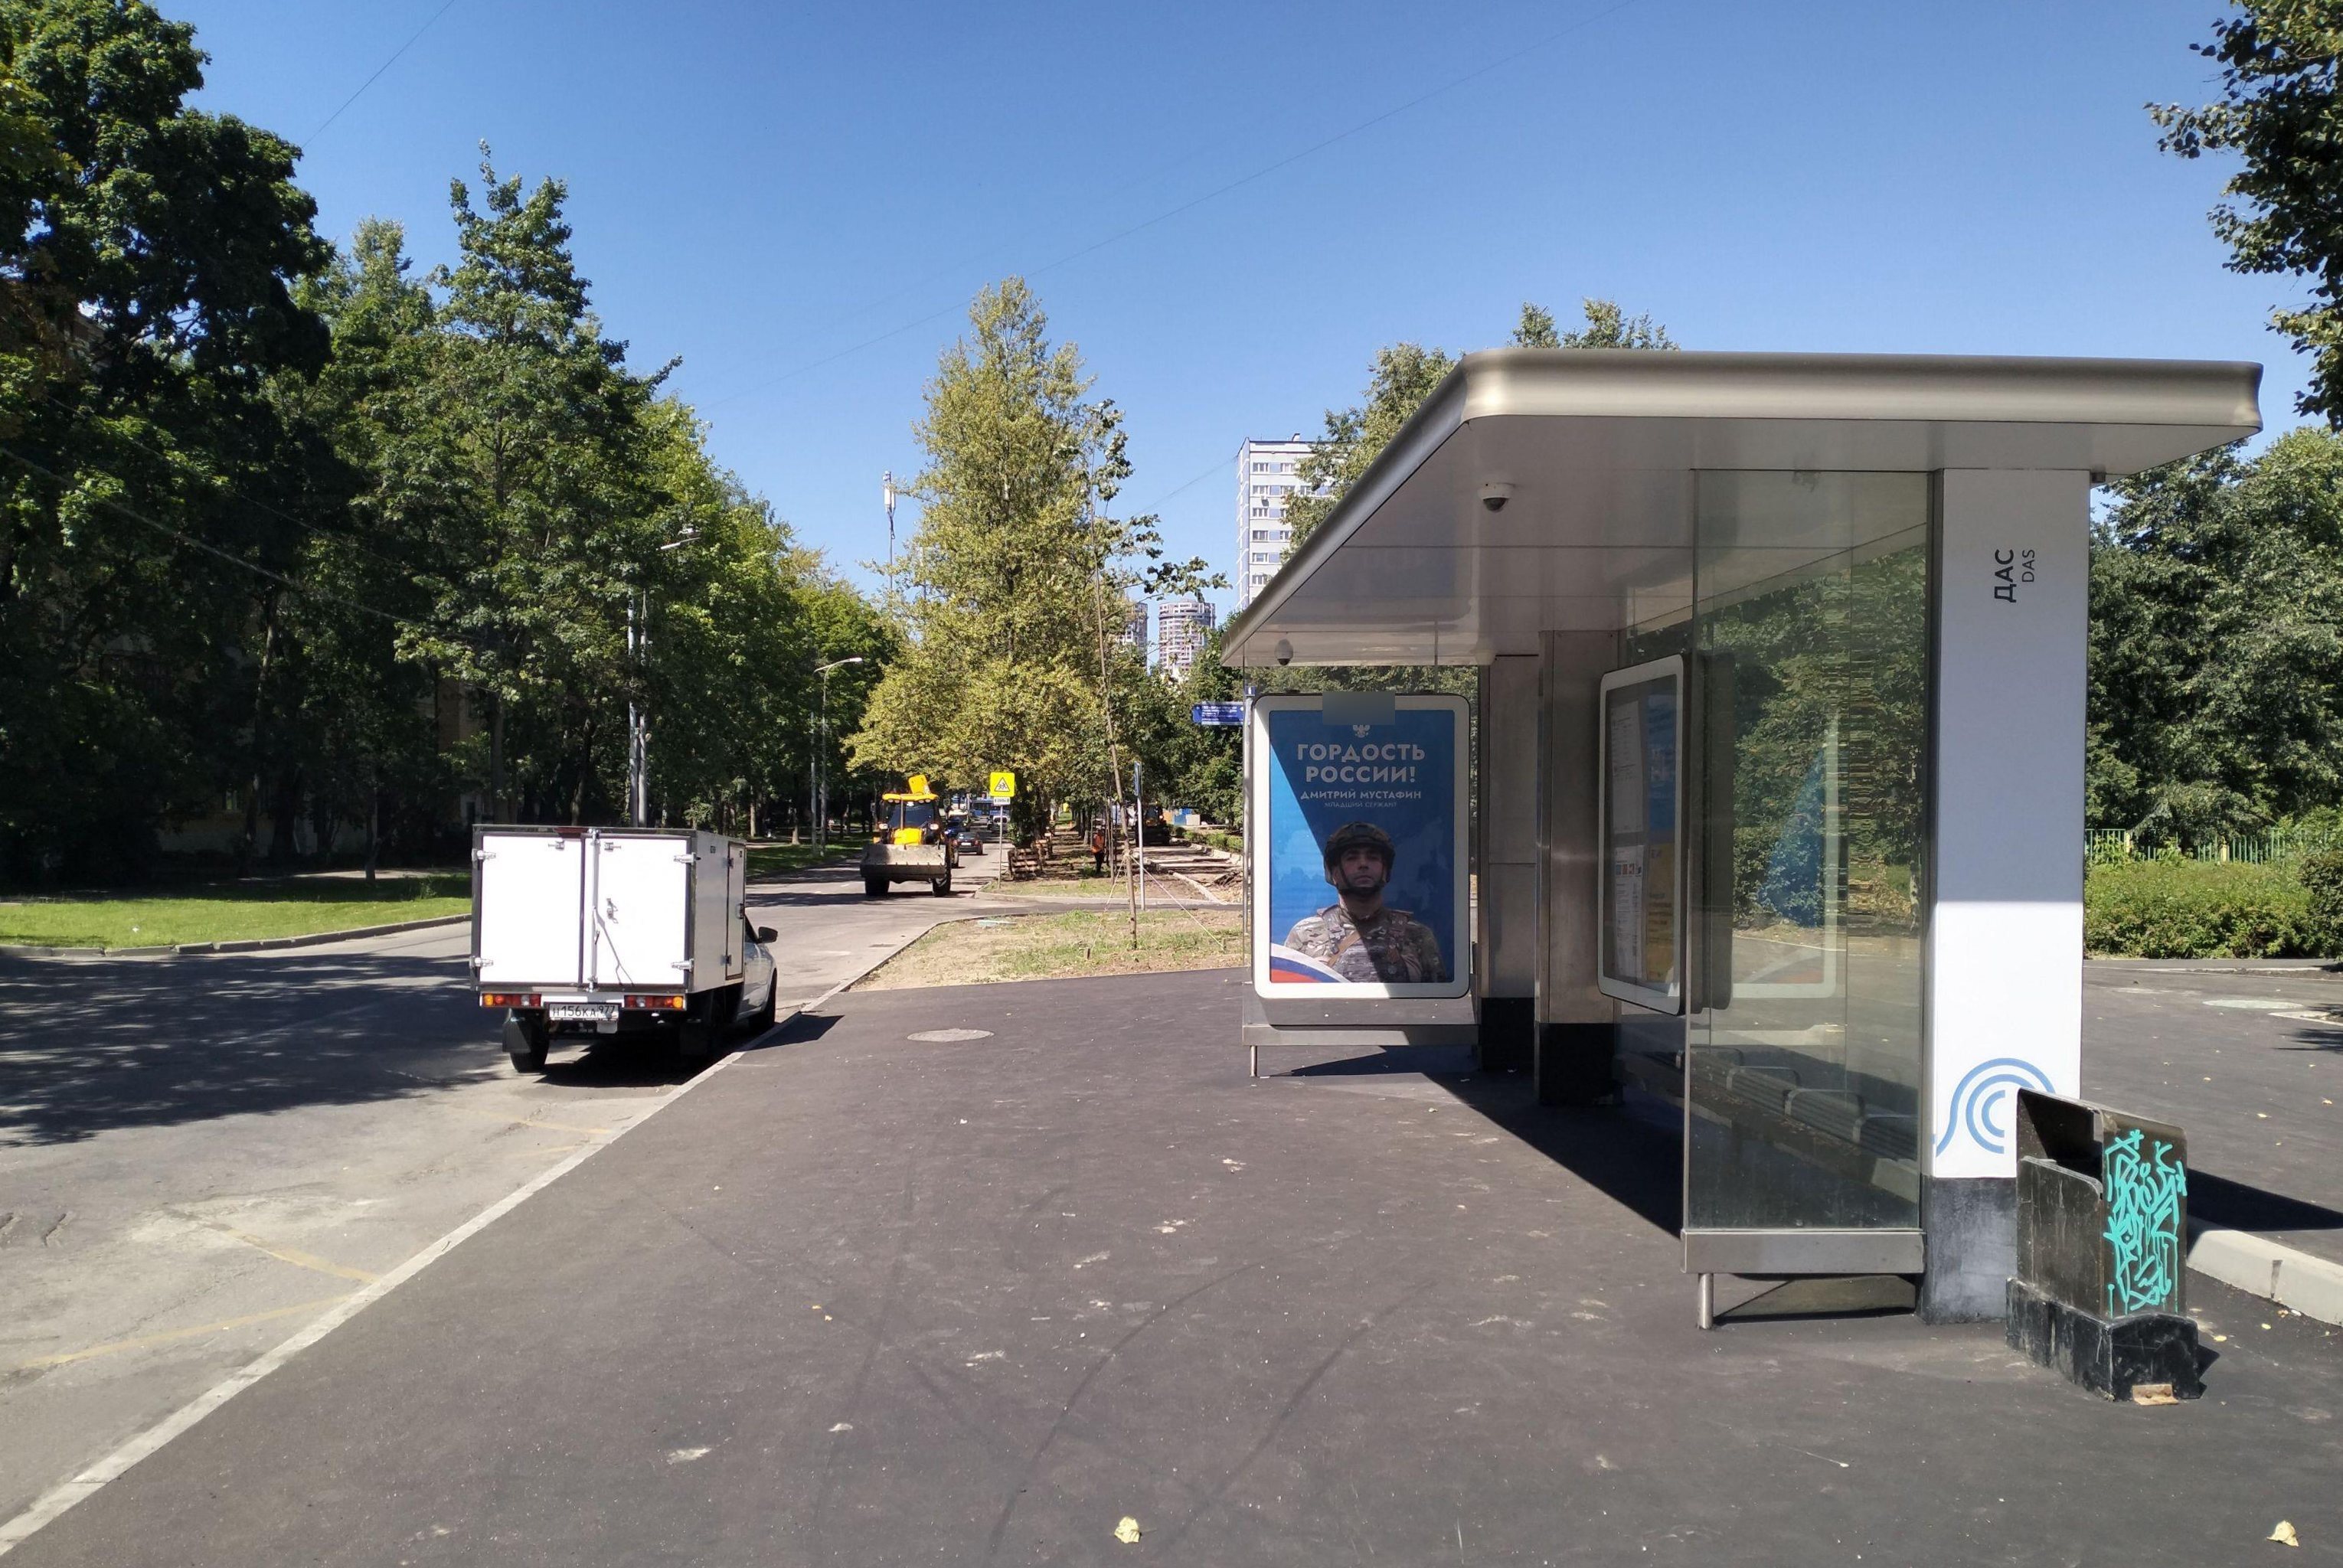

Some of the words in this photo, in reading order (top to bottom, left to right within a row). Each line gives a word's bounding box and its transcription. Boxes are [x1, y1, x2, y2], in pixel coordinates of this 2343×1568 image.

[1994, 549, 2017, 603] ДАС
[2021, 550, 2035, 582] DAS
[1298, 743, 1426, 763] ГОРДОСТЬ
[1305, 766, 1416, 782] РОССИИ!
[1301, 789, 1356, 799] ДМИТРИЙ
[1360, 791, 1422, 799] МУСТАФИН
